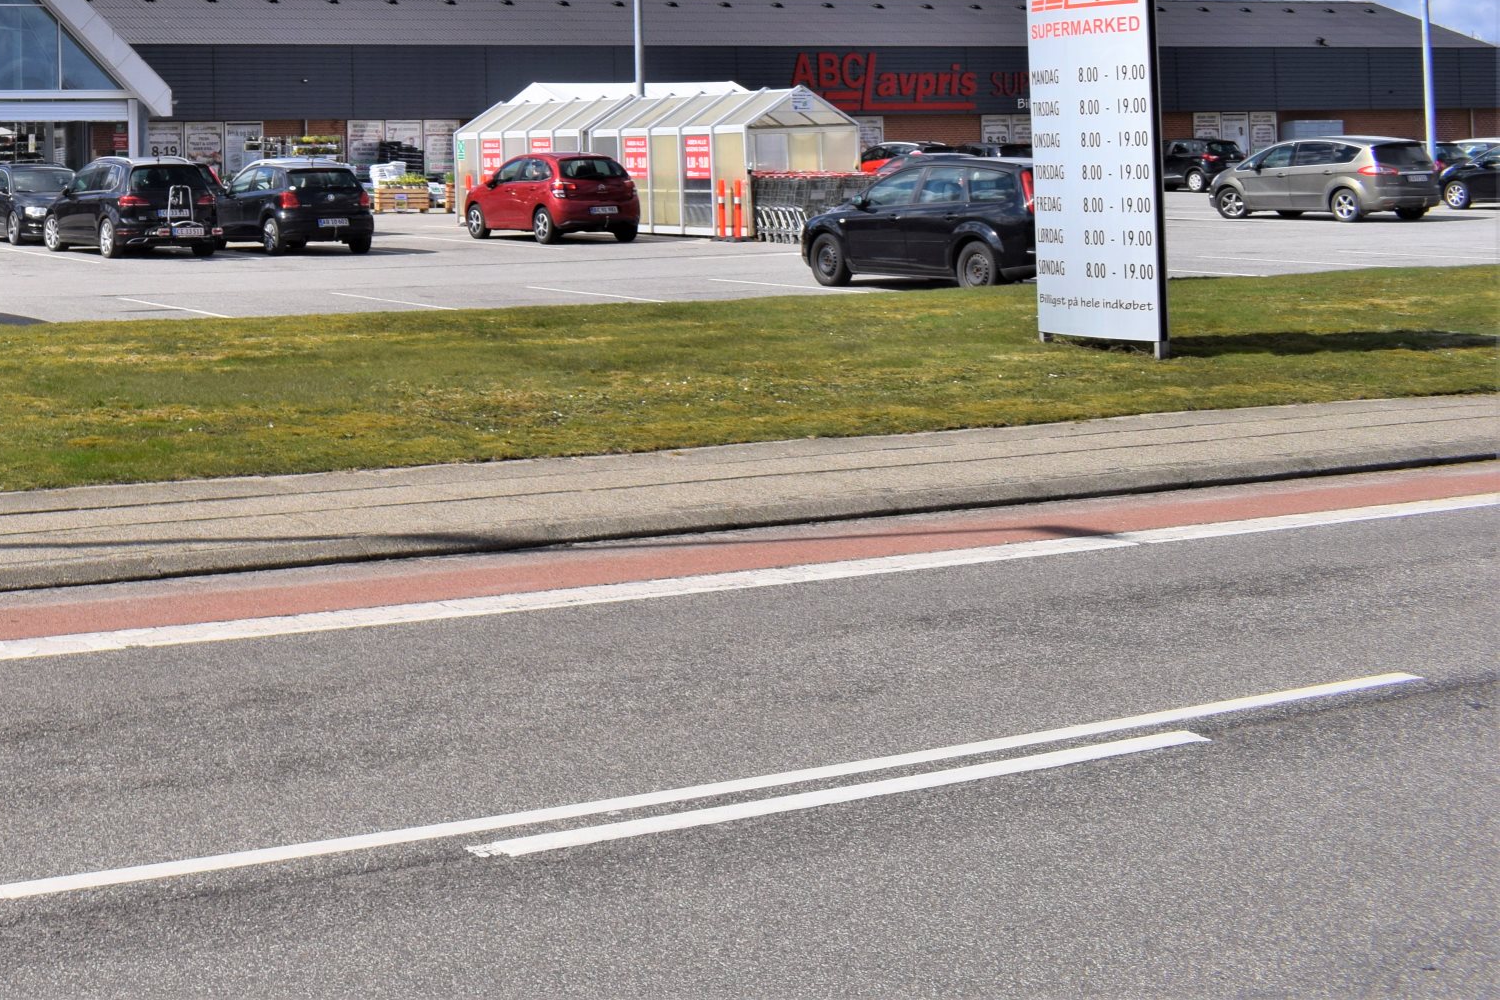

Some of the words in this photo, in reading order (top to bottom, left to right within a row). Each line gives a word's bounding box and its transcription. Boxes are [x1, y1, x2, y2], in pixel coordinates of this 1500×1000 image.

[1031, 15, 1140, 39] SUPERMARKED
[1031, 69, 1059, 85] MANDAG
[1078, 67, 1098, 82] 8.00
[1116, 64, 1145, 80] 19.00
[1032, 101, 1060, 116] TIRSDAG
[1080, 99, 1099, 115] 8.00
[1117, 97, 1147, 114] 19.00
[1033, 133, 1060, 148] ONSDAG
[1081, 132, 1101, 148] 8.00
[1118, 130, 1148, 147] 19.00
[151, 145, 178, 157] 8-19
[1035, 164, 1065, 180] TORSDAG
[1082, 164, 1102, 180] 8.00
[1120, 164, 1150, 180] 19.00
[1036, 196, 1062, 212] FREDAG
[1083, 197, 1104, 213] 8.00
[1121, 197, 1151, 213] 19.00
[1037, 228, 1064, 244] LØRDAG
[1084, 230, 1105, 246] 8.00
[1122, 230, 1152, 246] 19.00
[1038, 259, 1066, 276] SØNDAG
[1086, 262, 1106, 278] 8.00
[1124, 263, 1153, 280] 19.00
[1067, 296, 1078, 309] på
[1080, 297, 1100, 308] hele
[1102, 298, 1154, 311] indkøbet
